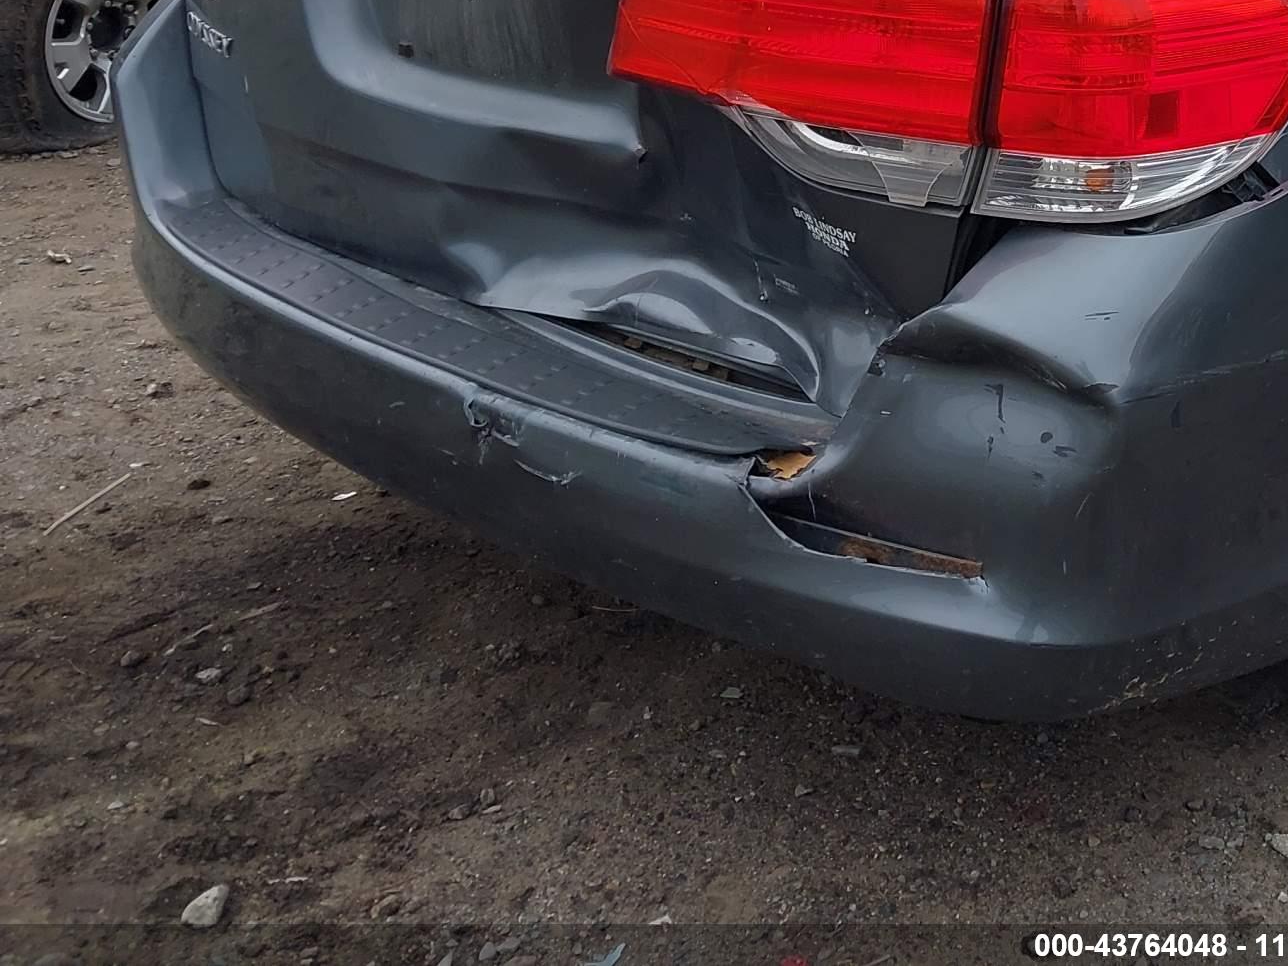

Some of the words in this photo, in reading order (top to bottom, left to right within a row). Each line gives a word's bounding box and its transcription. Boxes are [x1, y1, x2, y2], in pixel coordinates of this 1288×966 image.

[792, 206, 813, 224] BOB
[813, 217, 857, 243] LINDSAY
[804, 221, 850, 251] HONDA
